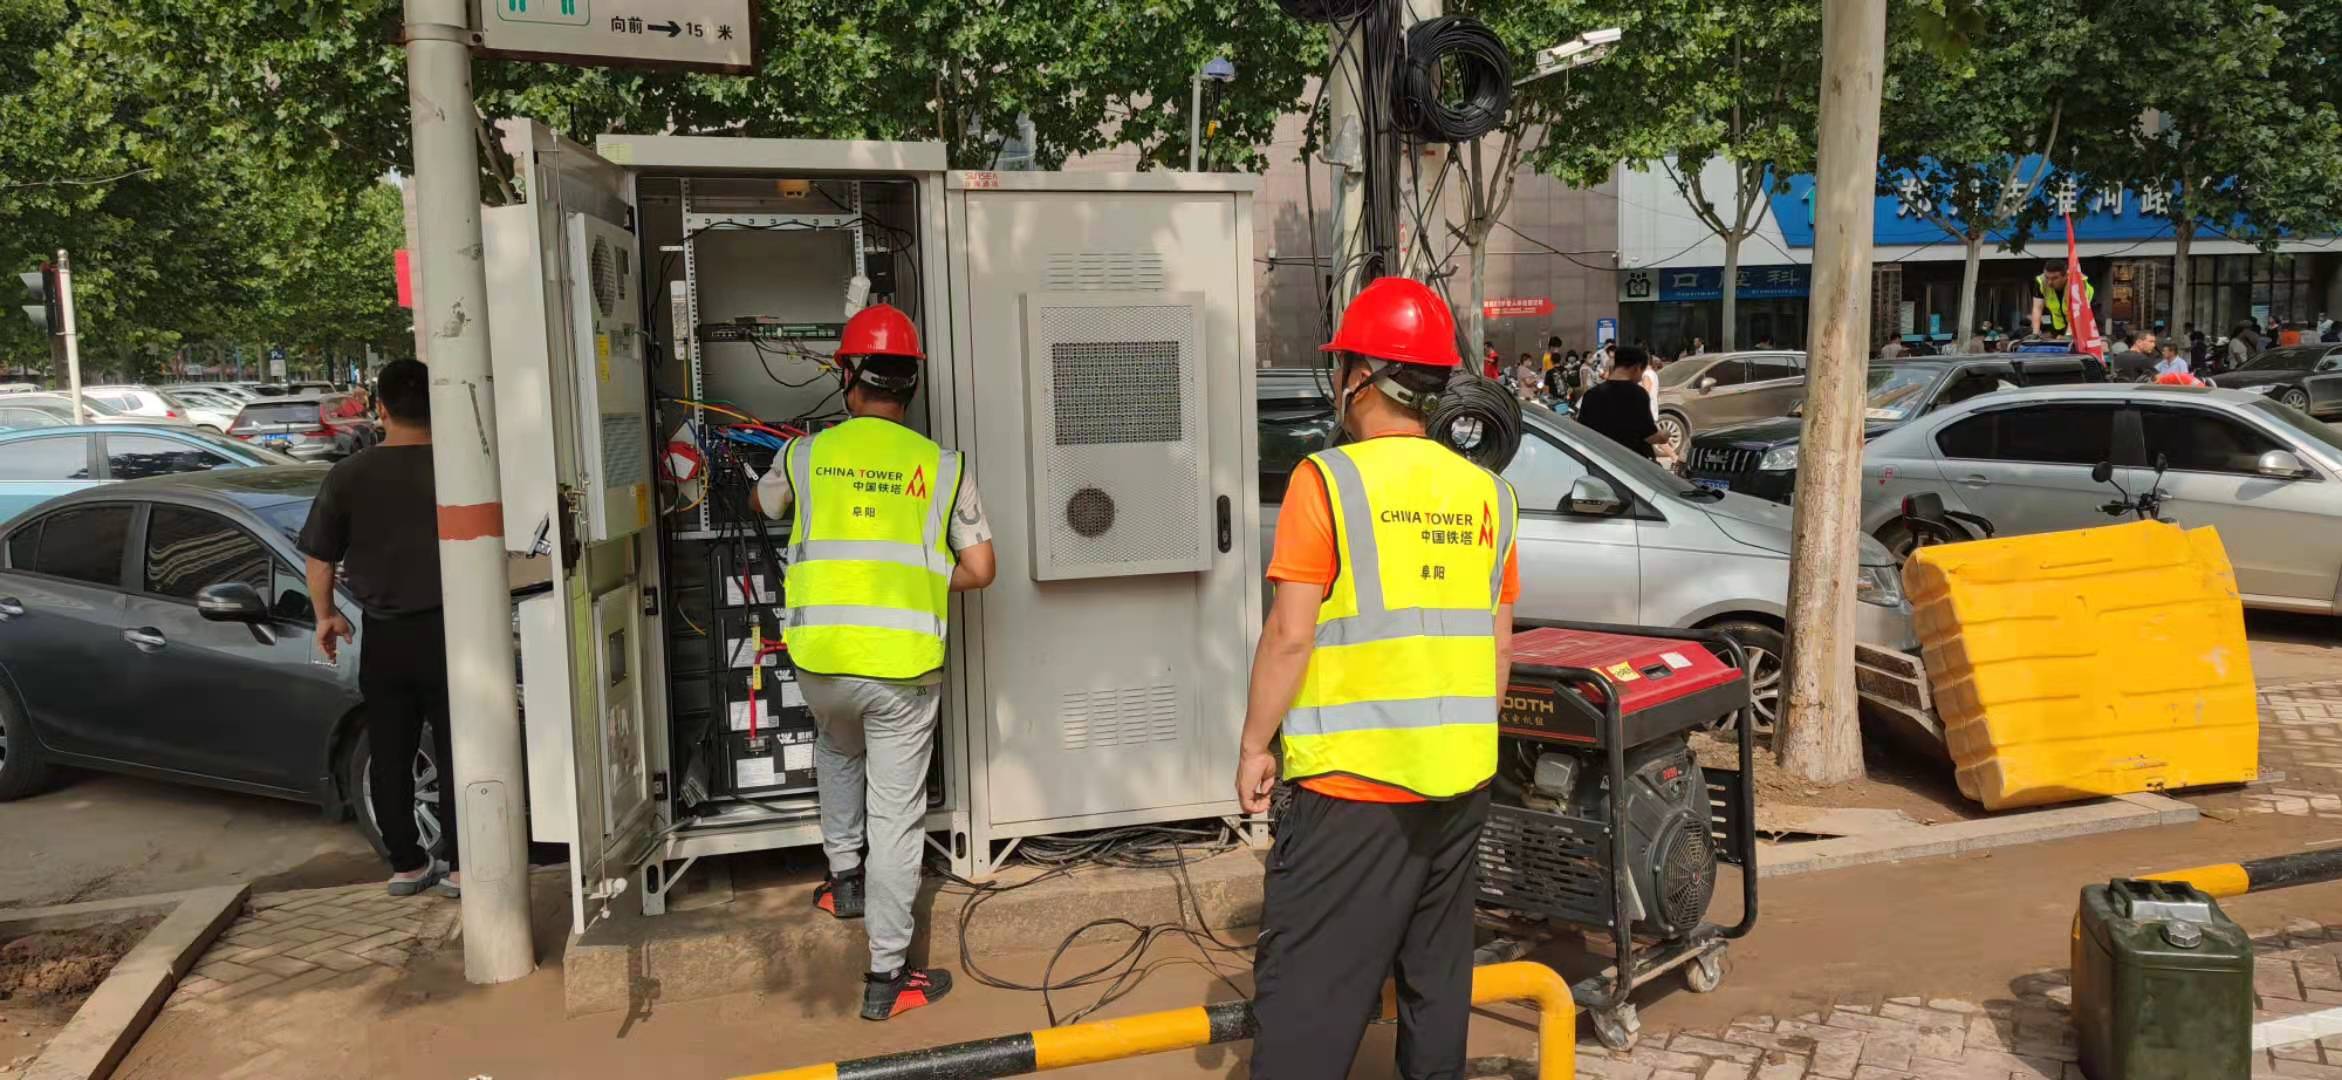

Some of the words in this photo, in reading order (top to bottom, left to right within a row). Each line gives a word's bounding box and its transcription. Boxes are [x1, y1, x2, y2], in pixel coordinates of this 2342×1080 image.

[610, 15, 643, 34] 向前
[717, 24, 733, 41] 米
[815, 466, 855, 478] CHINA
[859, 469, 903, 481] TOWER
[852, 480, 902, 496] 中国铁塔
[852, 505, 876, 518] 阜阳
[1380, 510, 1422, 524] CHINA
[1424, 512, 1473, 526] TOWER
[1420, 529, 1473, 546] 中国铁塔
[1420, 564, 1446, 581] 阜阳
[1503, 697, 1555, 713] OOTH
